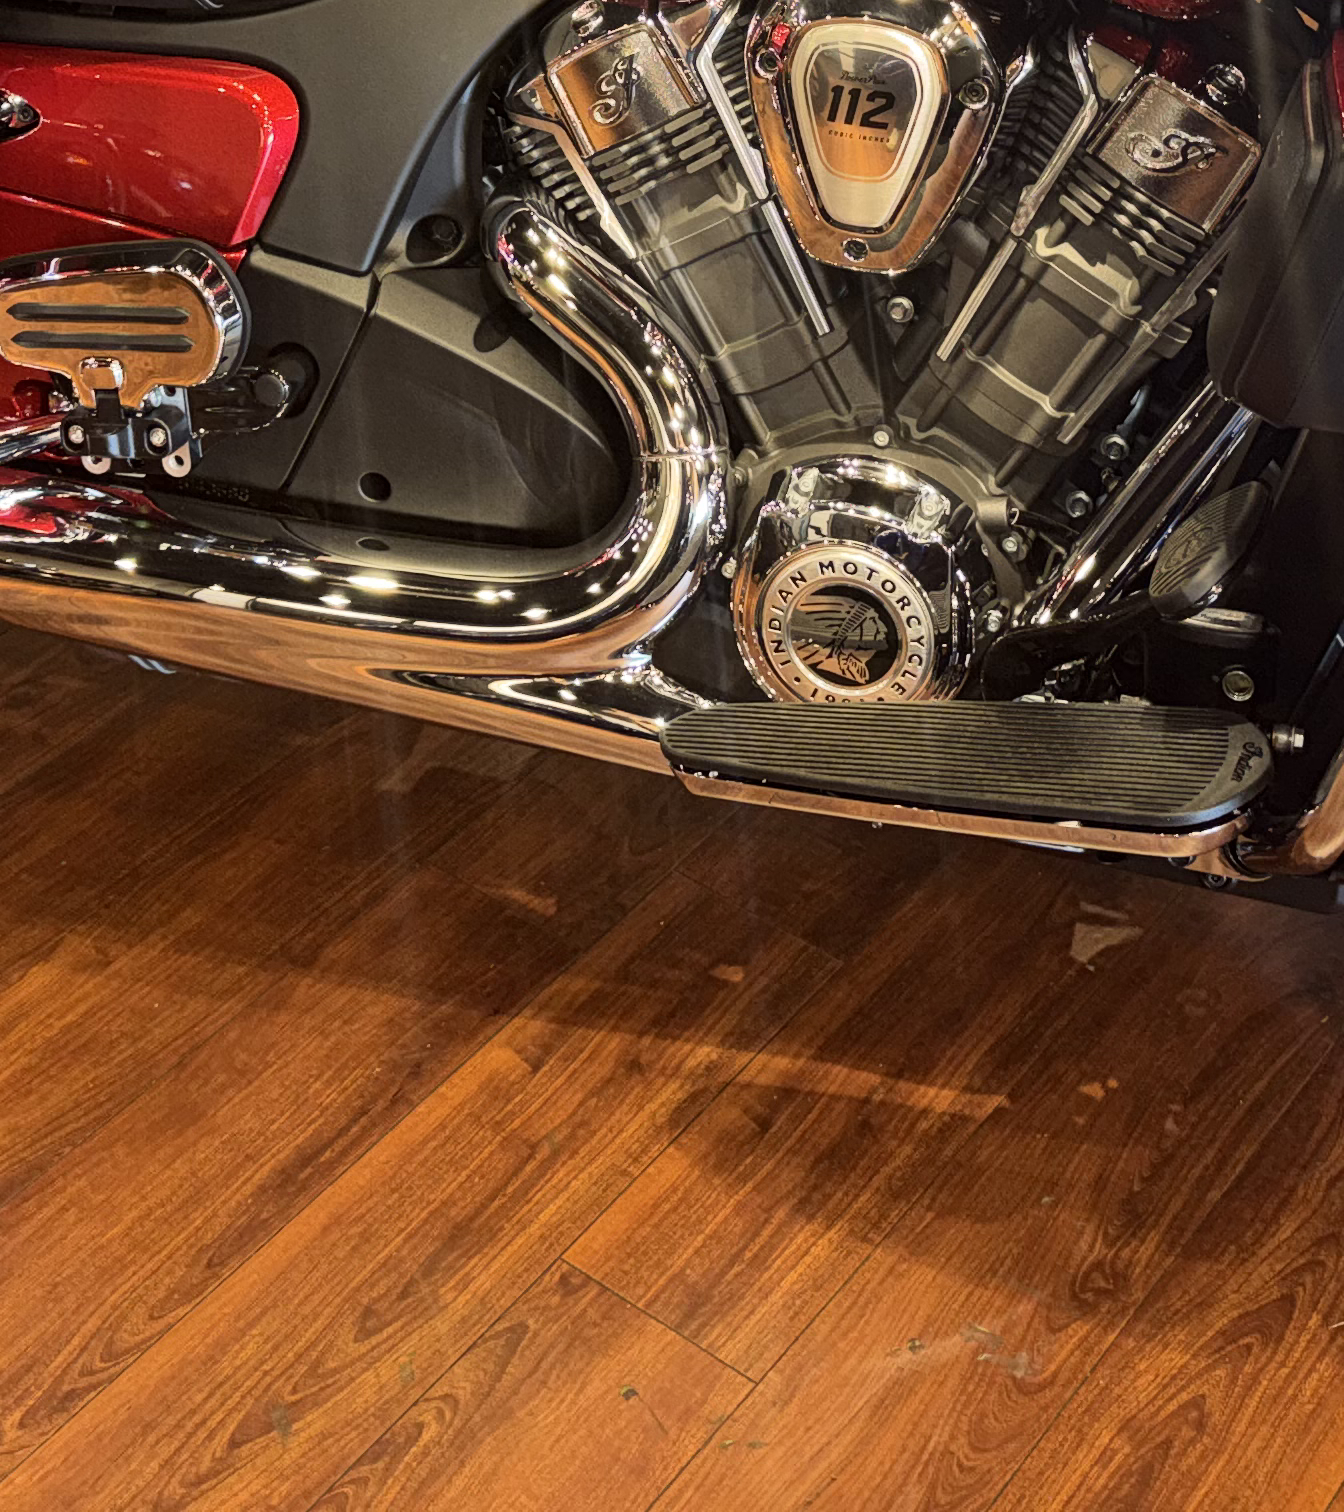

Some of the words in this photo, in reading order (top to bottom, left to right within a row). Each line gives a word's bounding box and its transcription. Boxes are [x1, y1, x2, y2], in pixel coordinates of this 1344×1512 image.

[827, 85, 896, 130] 112
[828, 129, 854, 139] CUBIC
[768, 571, 807, 668] INDIAN
[818, 560, 925, 696] MOTORCYCLE
[1231, 742, 1263, 783] Indian
